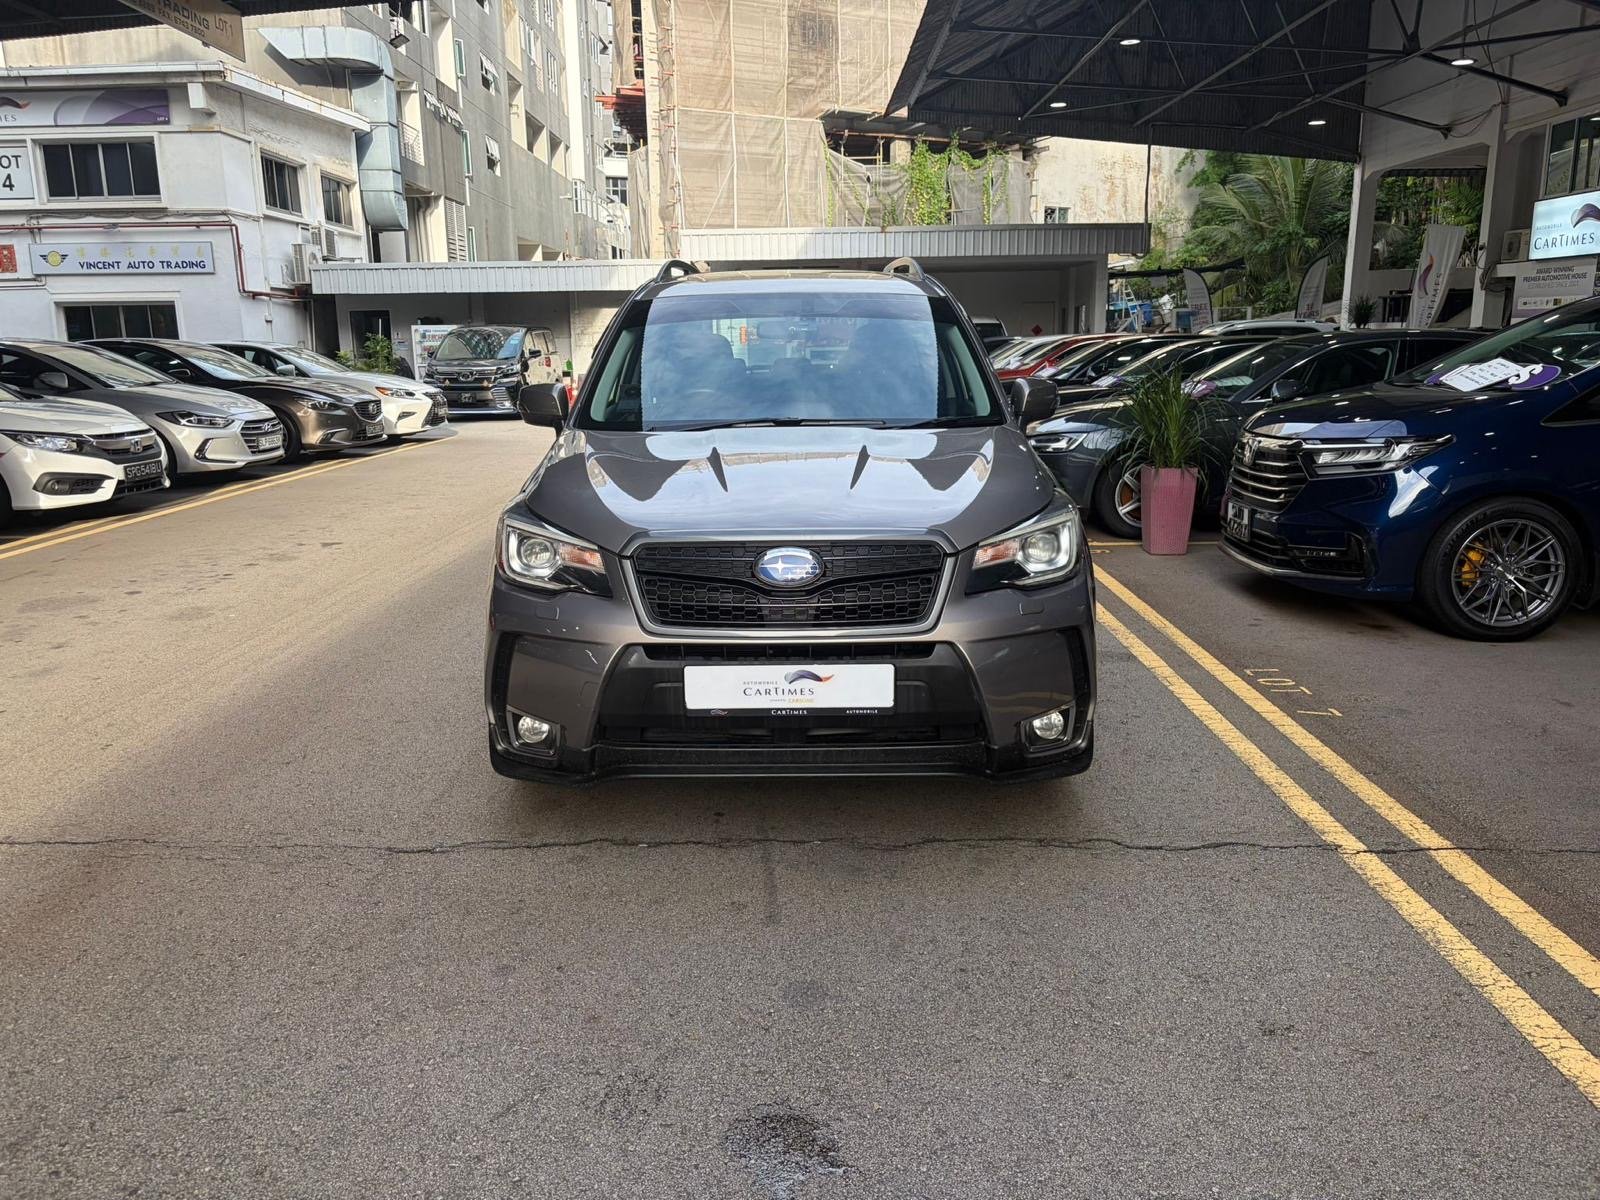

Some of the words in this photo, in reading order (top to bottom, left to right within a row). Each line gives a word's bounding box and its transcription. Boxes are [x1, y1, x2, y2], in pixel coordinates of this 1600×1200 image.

[214, 15, 229, 35] LOT
[2, 173, 15, 192] 4
[79, 261, 121, 270] VINCENT
[127, 260, 155, 270] AUTO
[159, 260, 206, 269] TRADING
